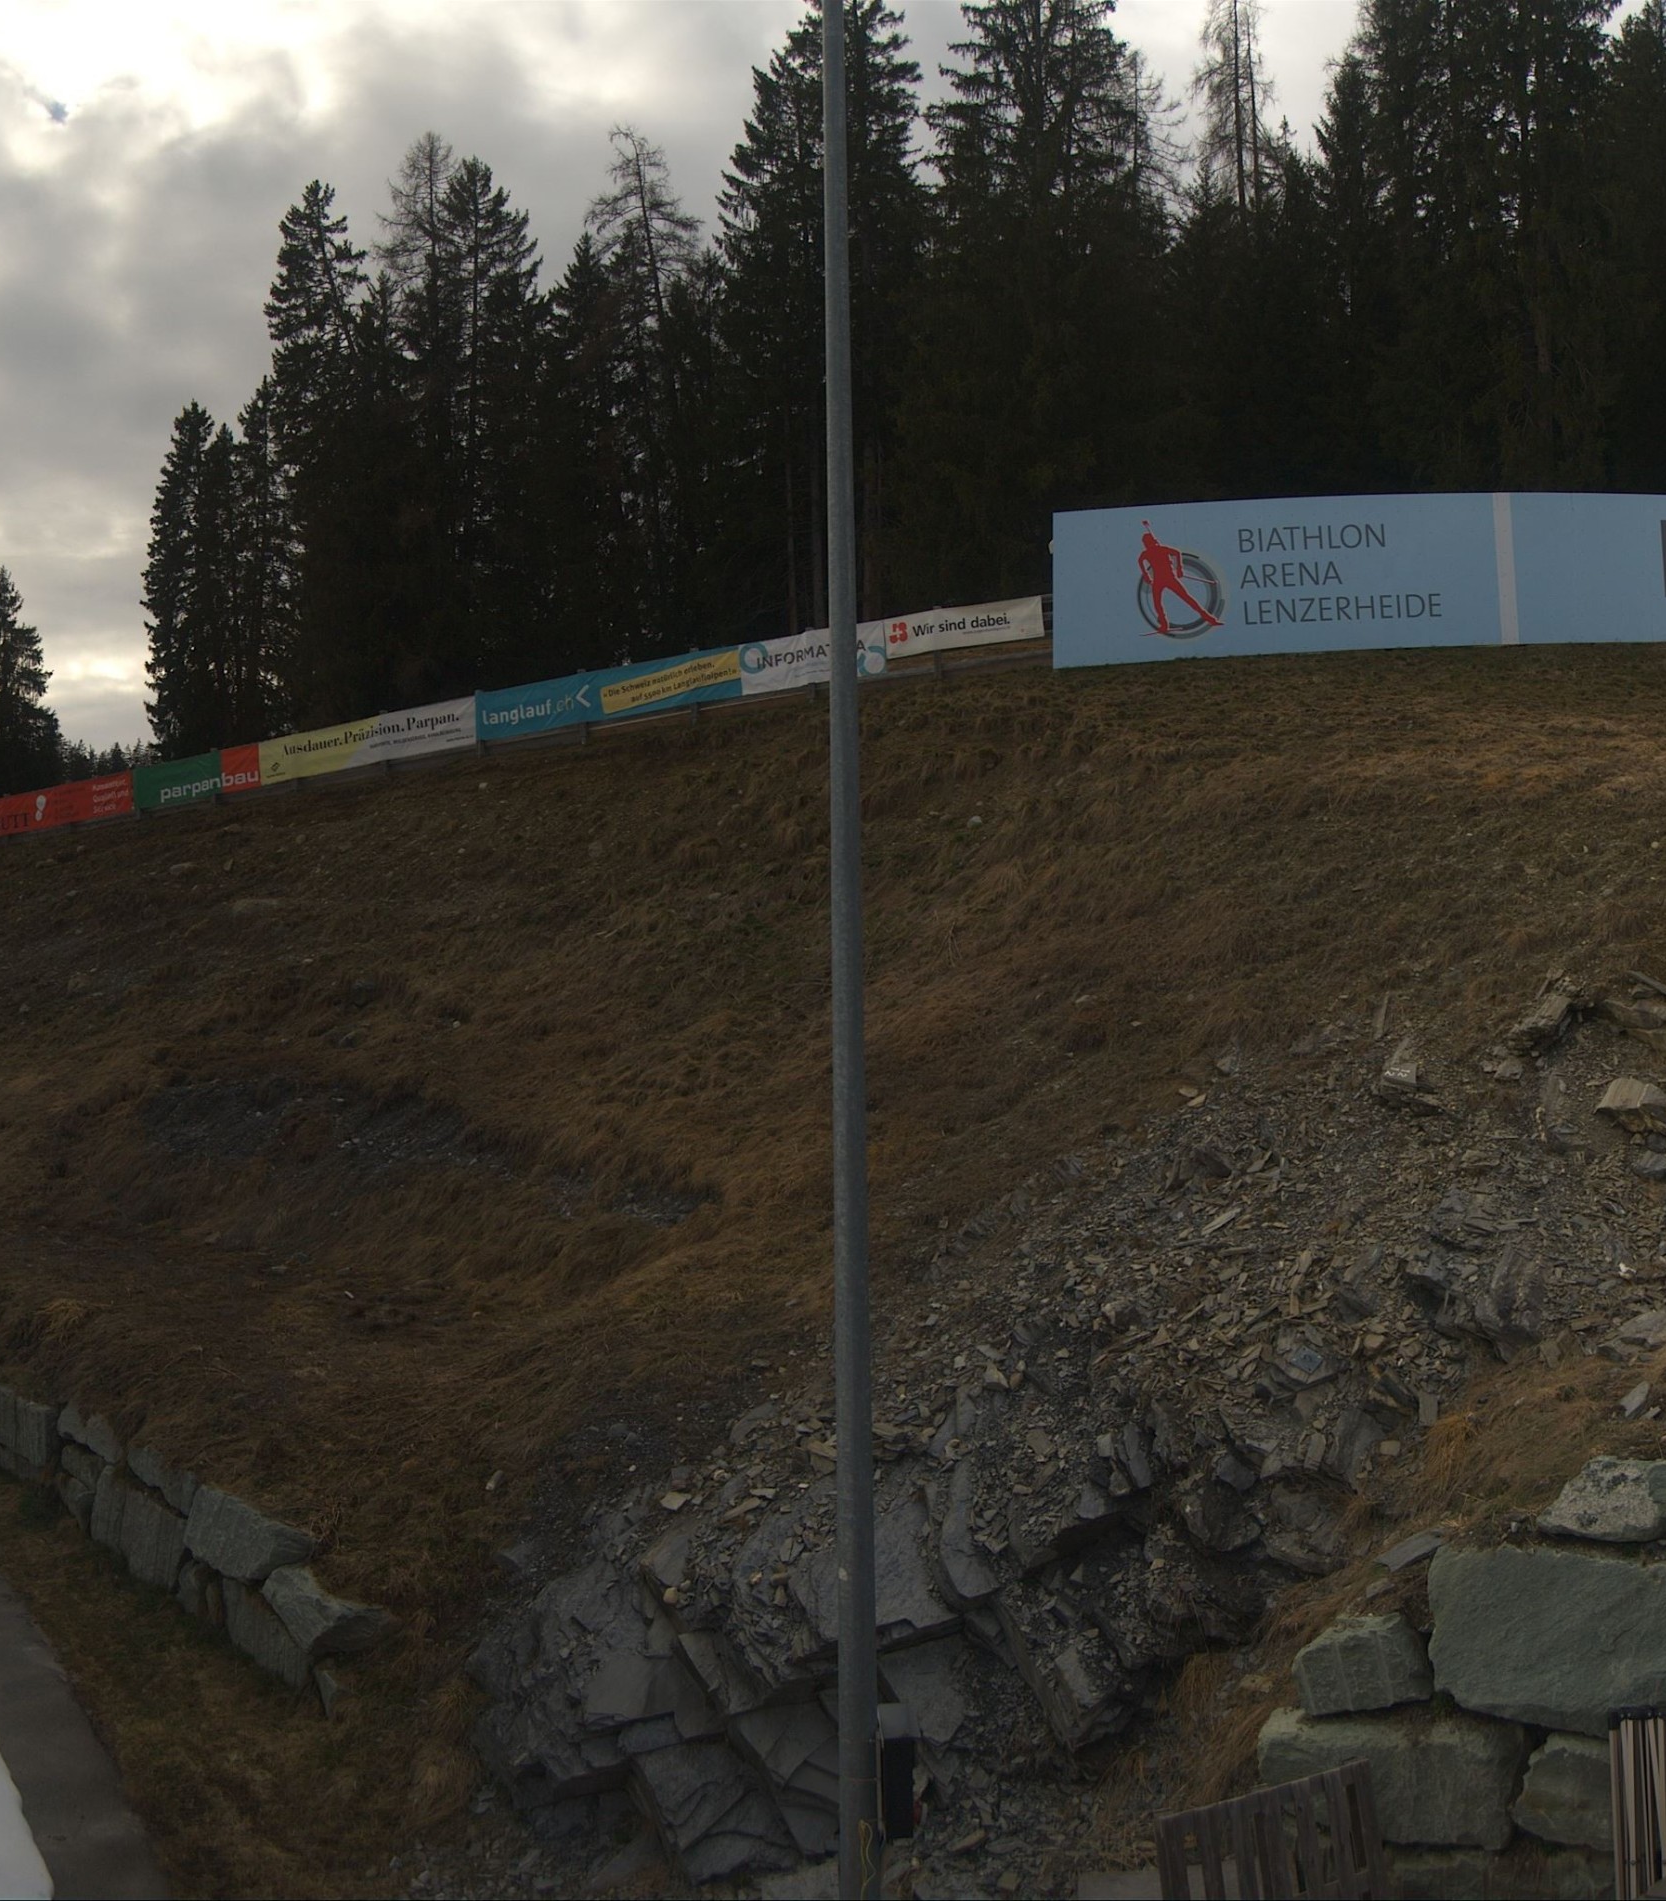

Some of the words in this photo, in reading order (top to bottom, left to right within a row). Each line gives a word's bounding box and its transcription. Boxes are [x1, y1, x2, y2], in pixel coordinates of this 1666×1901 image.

[1238, 523, 1386, 553] BIATHLON
[1240, 561, 1343, 589] ARENA
[1244, 593, 1442, 625] LENZERHEIDE
[912, 624, 935, 637] Wir
[939, 618, 966, 632] sind
[971, 613, 1011, 628] dabei.
[620, 680, 651, 692] Schweiz
[407, 712, 460, 731] Parpan.
[482, 694, 575, 725] langlauf.ch
[160, 770, 259, 802] parpanbau
